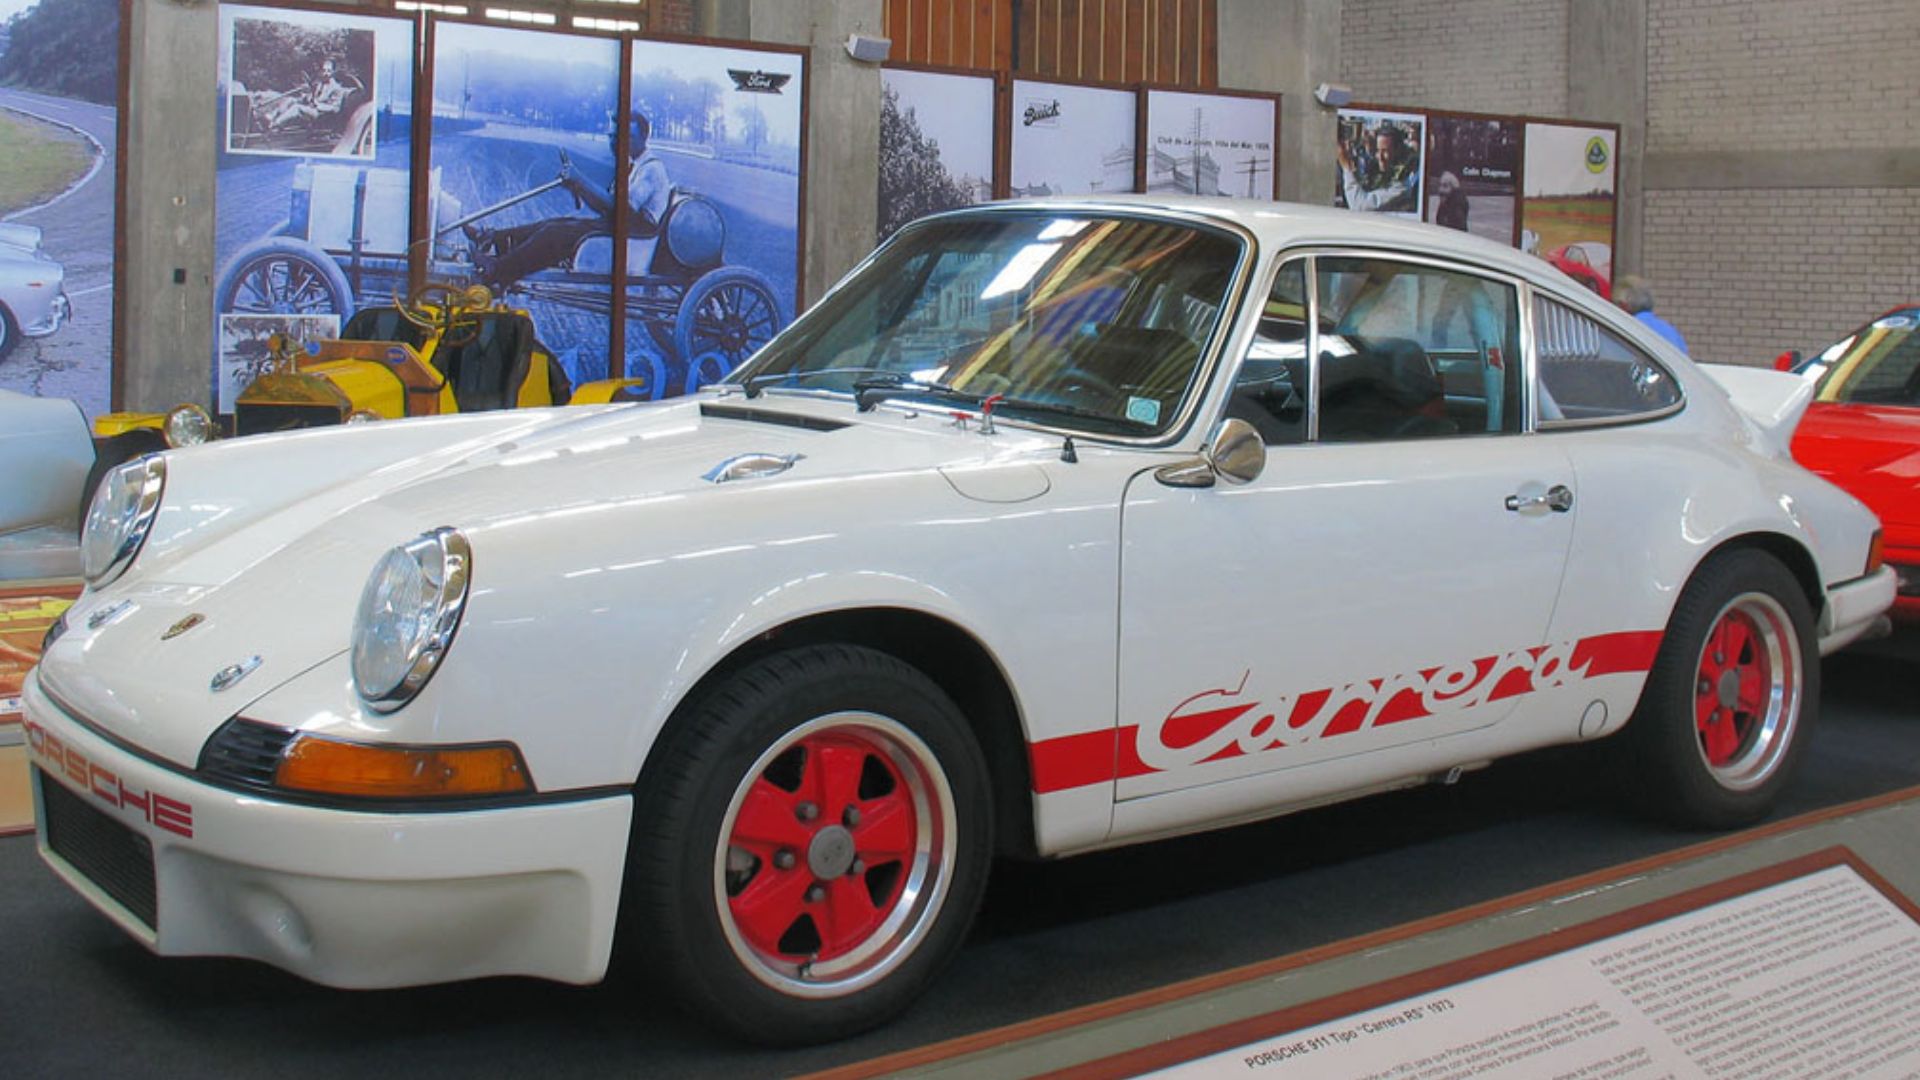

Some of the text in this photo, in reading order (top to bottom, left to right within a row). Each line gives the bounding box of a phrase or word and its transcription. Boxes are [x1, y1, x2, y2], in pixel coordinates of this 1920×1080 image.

[1023, 99, 1060, 126] Buick
[1462, 165, 1480, 177] Colin
[1135, 638, 1593, 771] Carrera
[24, 719, 193, 839] ORSCHE
[1244, 1040, 1310, 1069] PORSCHE
[1306, 1035, 1330, 1051] 911
[1328, 1030, 1358, 1045] Tipo
[1426, 998, 1455, 1014] 1973
